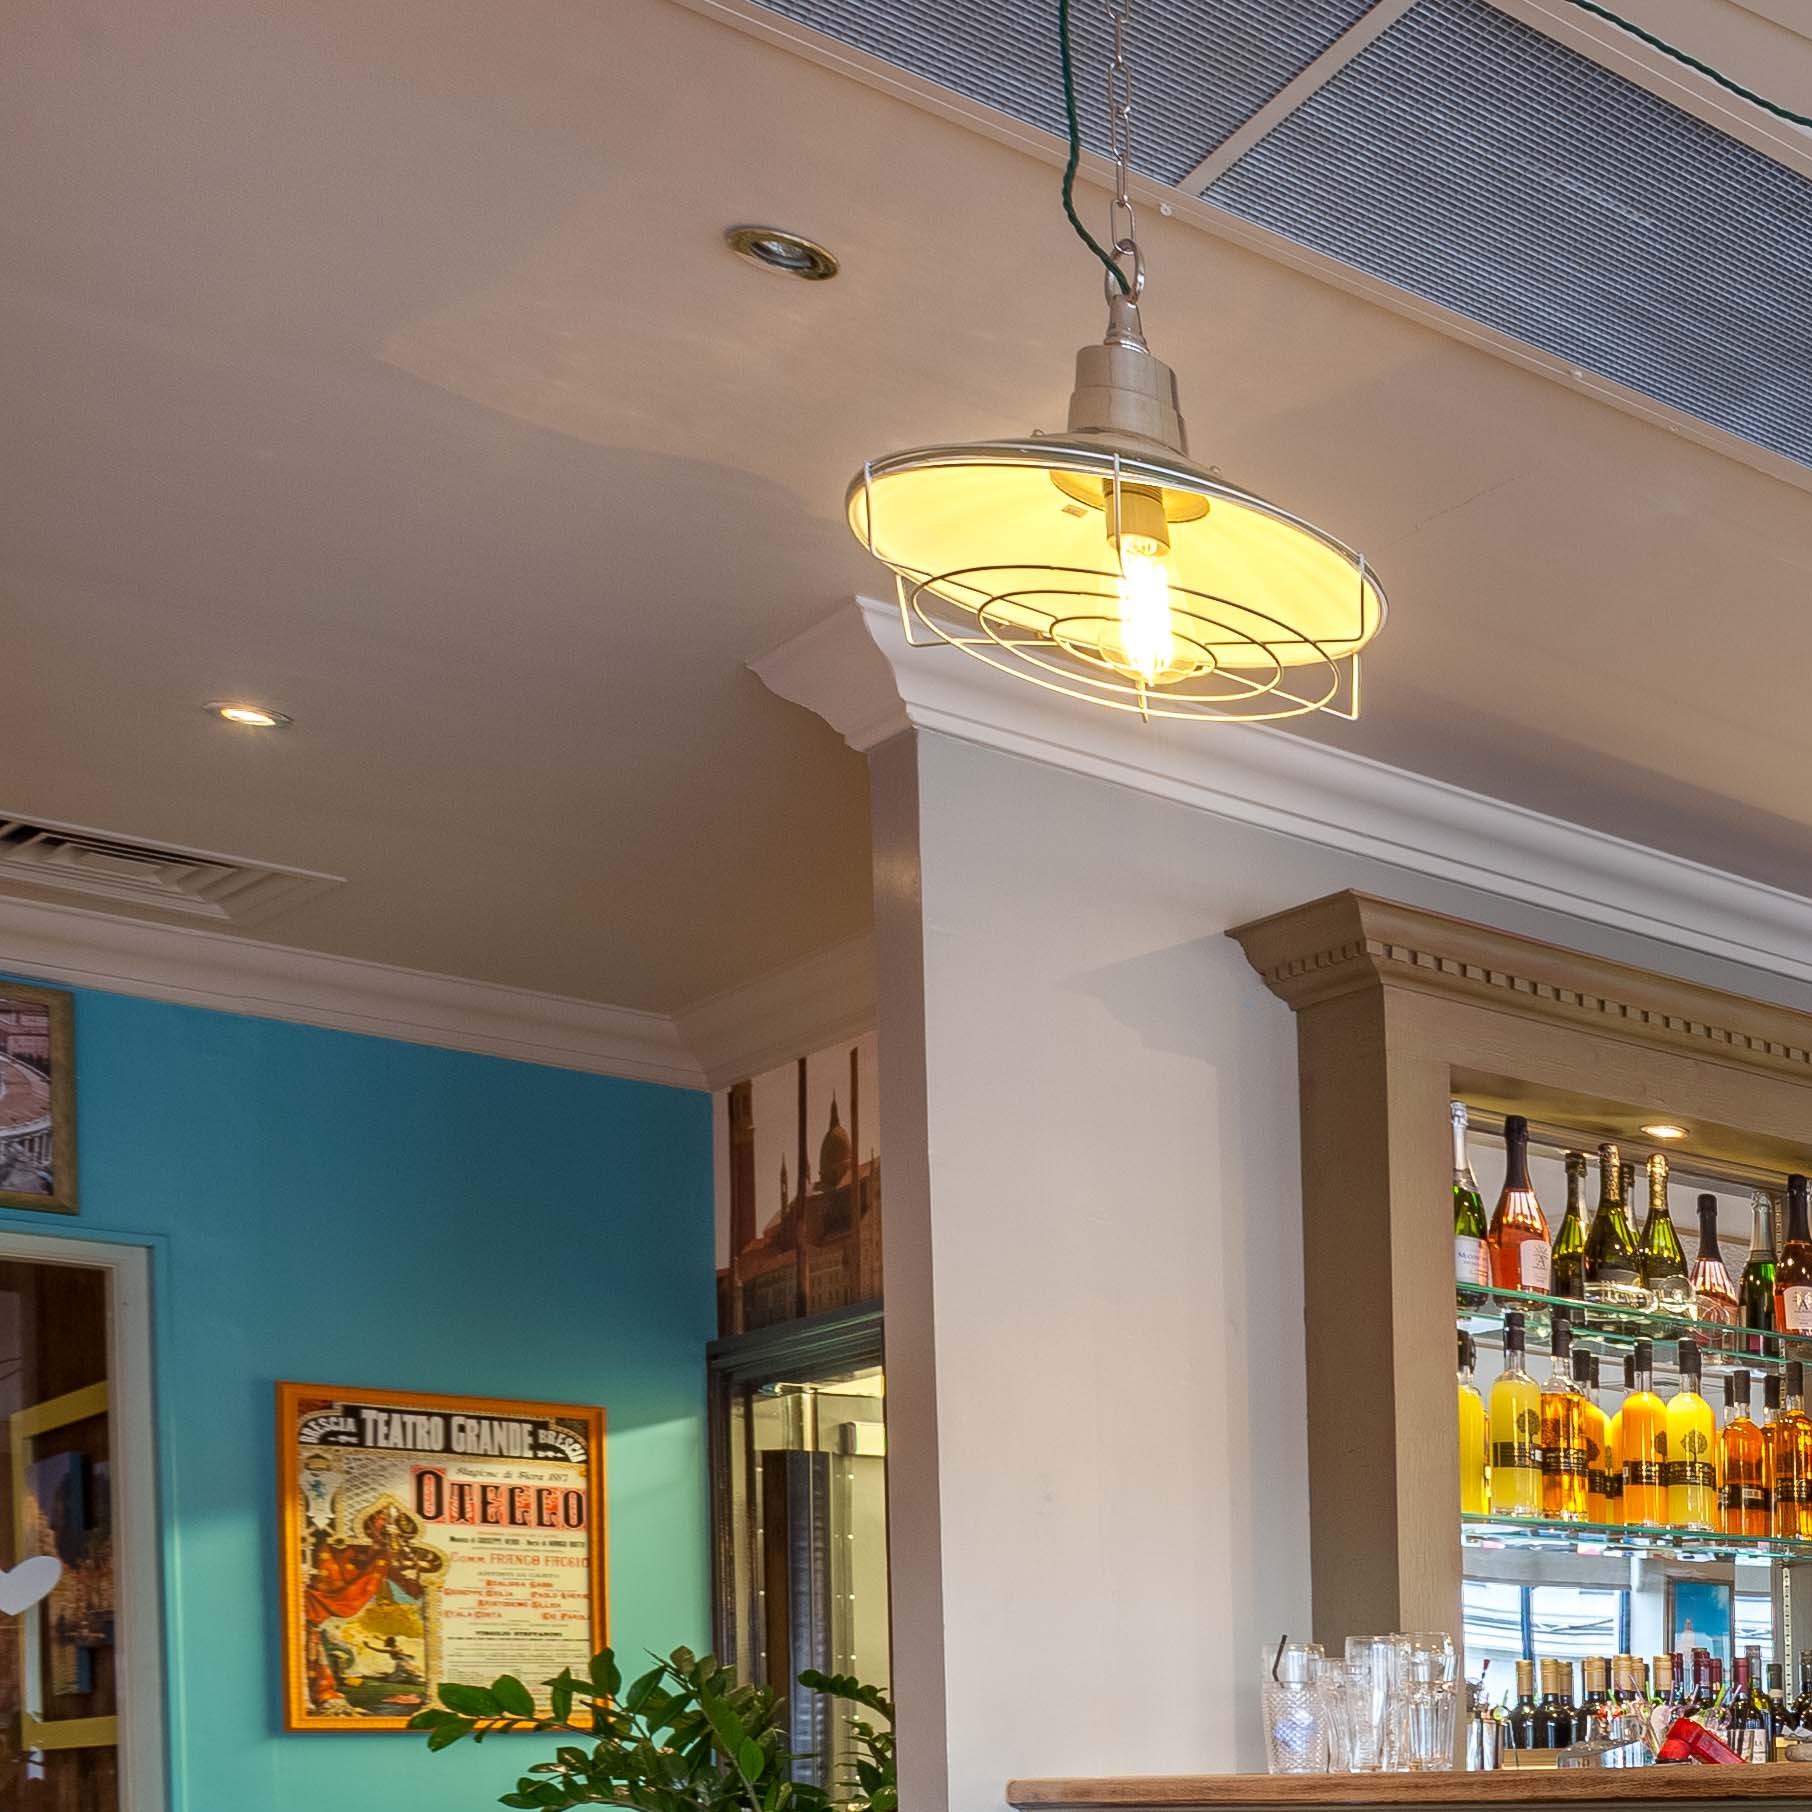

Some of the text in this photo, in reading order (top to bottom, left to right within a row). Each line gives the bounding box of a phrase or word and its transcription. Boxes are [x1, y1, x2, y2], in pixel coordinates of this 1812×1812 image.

[300, 1416, 357, 1444] BRESCIA
[361, 1409, 534, 1458] TEATRO GRANDE
[538, 1429, 588, 1464] BRESCIA
[414, 1469, 585, 1529] OTELLO
